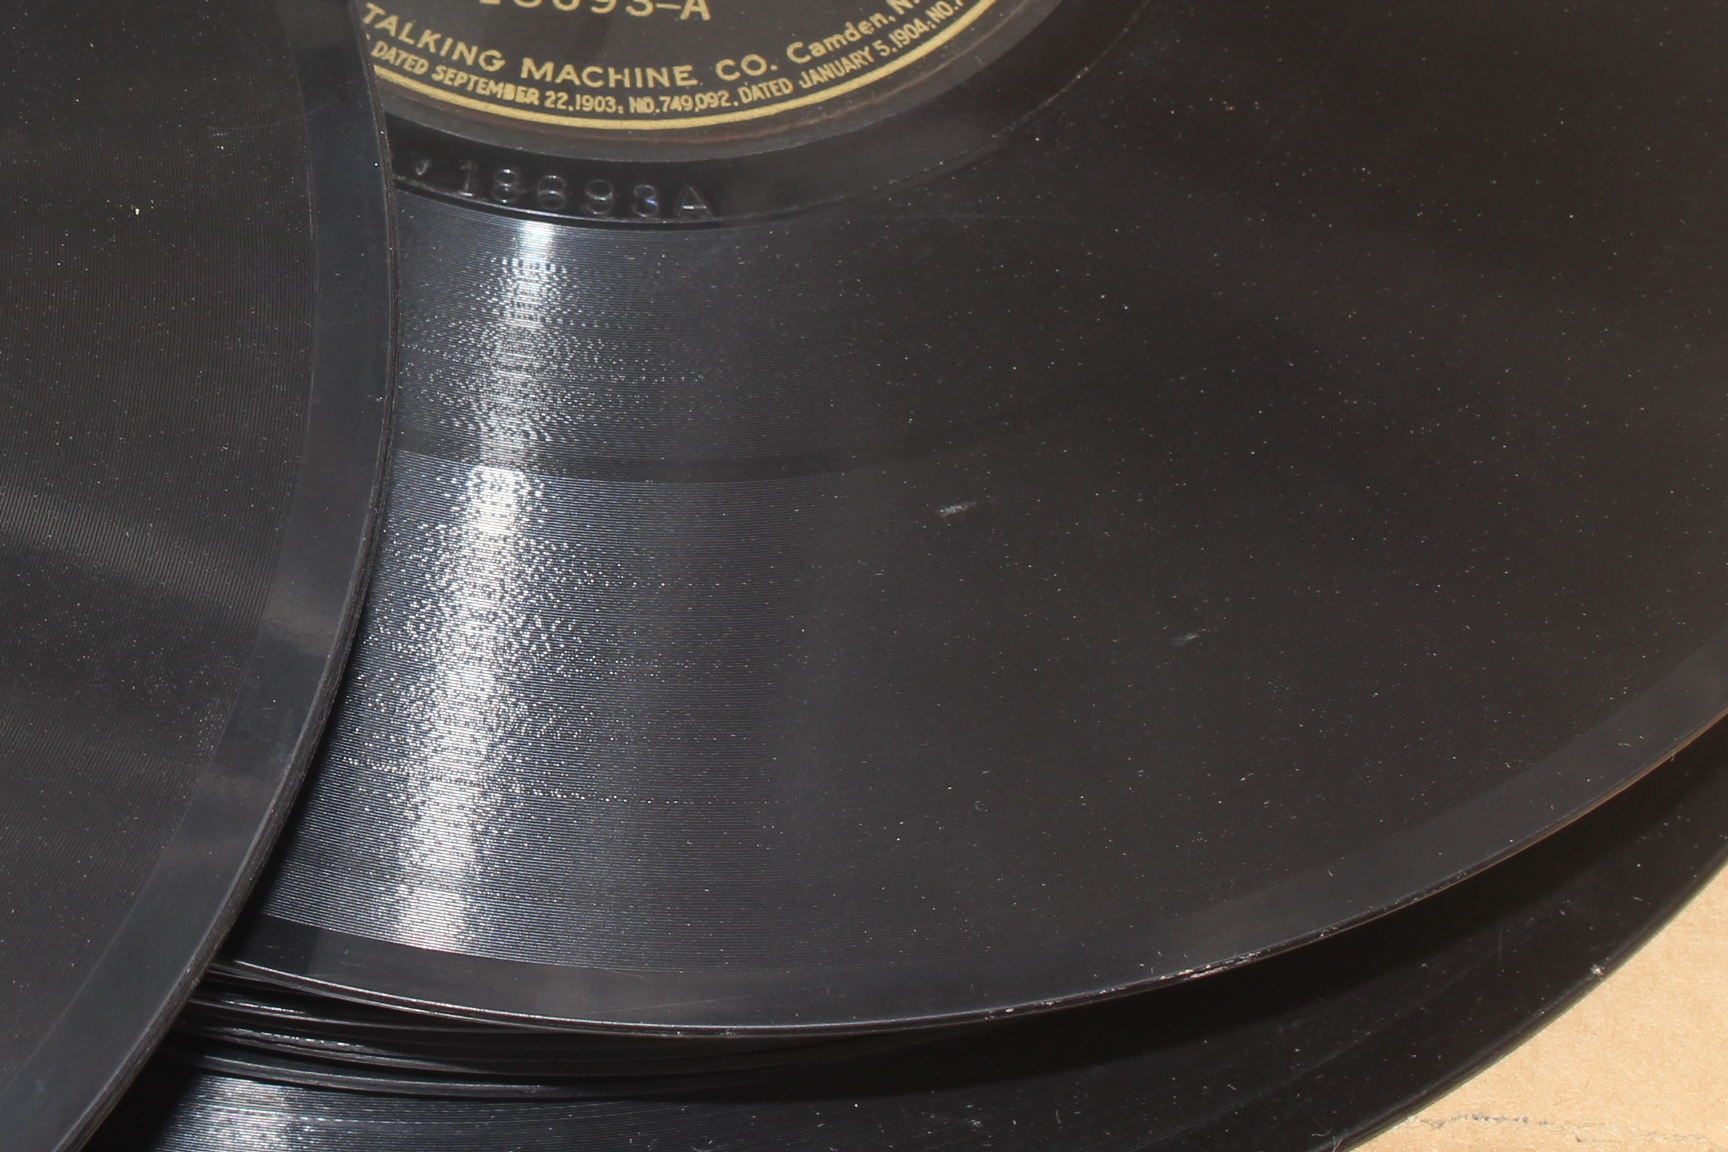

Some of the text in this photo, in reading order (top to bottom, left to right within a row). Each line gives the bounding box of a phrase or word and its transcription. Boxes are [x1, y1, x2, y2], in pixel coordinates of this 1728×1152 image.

[363, 2, 506, 72] TALKING
[520, 57, 698, 90] MACHINE
[715, 53, 778, 82] CO.
[786, 11, 896, 64] Camden,
[372, 40, 428, 75] DATED
[431, 64, 540, 105] SEPTEMBER
[737, 77, 793, 105] DATED
[798, 47, 875, 90] JANUARY
